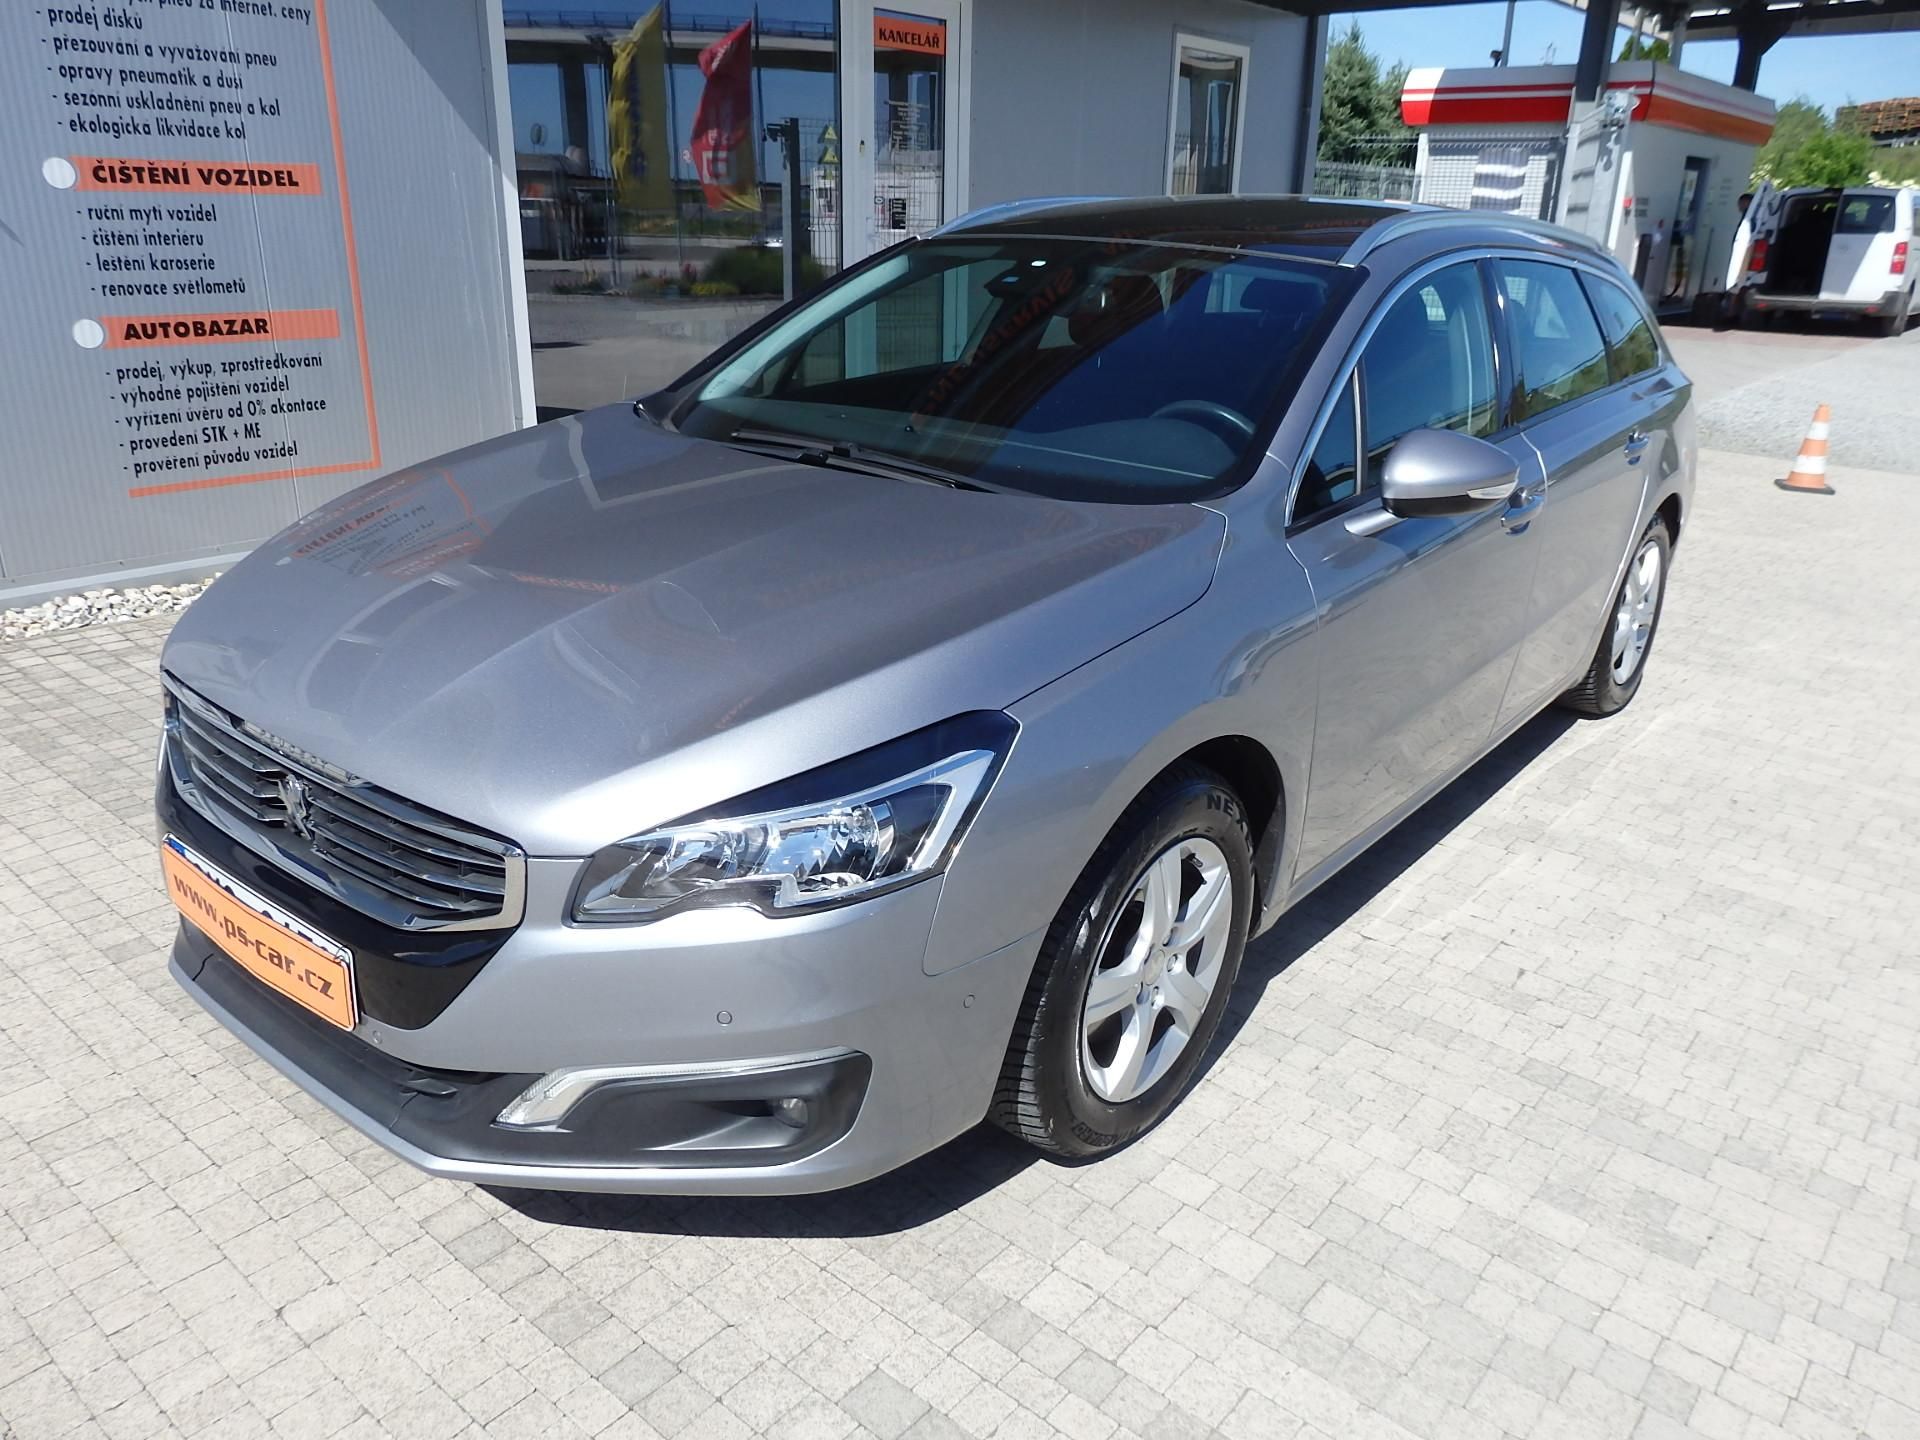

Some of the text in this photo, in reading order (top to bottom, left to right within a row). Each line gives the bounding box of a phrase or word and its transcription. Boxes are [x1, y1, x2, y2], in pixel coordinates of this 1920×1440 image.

[47, 4, 99, 31] prodej
[199, 0, 215, 10] za
[281, 5, 311, 25] ceny
[879, 27, 940, 49] KANCELÁŘ
[53, 33, 139, 57] přezouvání
[144, 44, 154, 58] a
[245, 52, 278, 69] pneu
[59, 65, 113, 86] opravy
[119, 67, 197, 87] pneumatik
[202, 74, 212, 88] a
[126, 90, 205, 112] uskladnění
[209, 99, 242, 118] pneu
[247, 103, 256, 115] a
[258, 97, 281, 117] kol
[155, 116, 221, 138] likvidace
[224, 120, 247, 140] kol
[92, 159, 300, 188] ČIŠTĚNÍ VOZIDEL
[88, 203, 125, 221] ruční
[167, 203, 218, 222] vozidel
[92, 227, 205, 247] čištění interiéru
[96, 252, 216, 272] leštění karoserie
[101, 276, 247, 297] renovace světlometů
[124, 317, 270, 341] AUTOBAZAR
[116, 359, 166, 384] prodej,
[221, 350, 323, 377] zprostředkování
[120, 375, 290, 408] výhodné pojištění vozidel
[228, 402, 243, 418] od
[247, 399, 266, 416] 0%
[271, 397, 328, 416] akontace
[130, 430, 199, 455] provedení
[202, 424, 229, 444] STK
[244, 422, 262, 440] ME
[134, 440, 299, 478] prověření původu vozidel
[173, 874, 335, 1001] www.ps-car.cz
